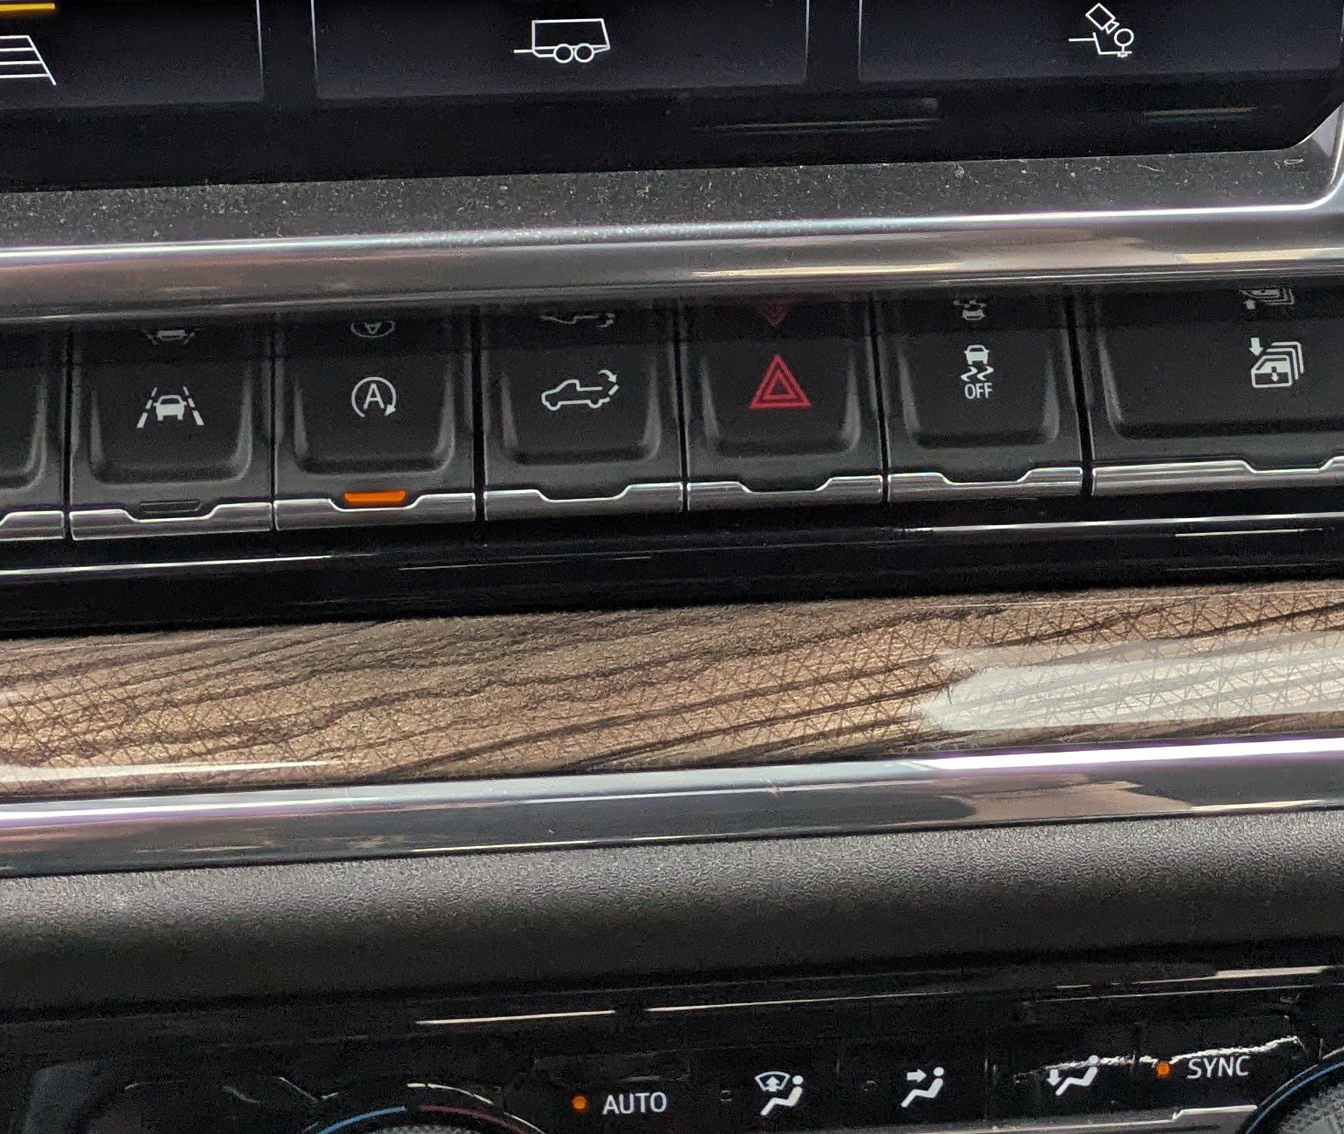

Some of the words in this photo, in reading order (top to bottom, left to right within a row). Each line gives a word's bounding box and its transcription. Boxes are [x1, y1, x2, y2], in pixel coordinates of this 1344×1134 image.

[363, 383, 385, 409] A
[964, 382, 993, 399] OFF
[1186, 1055, 1251, 1079] SYNC
[602, 1091, 667, 1115] AUTO
